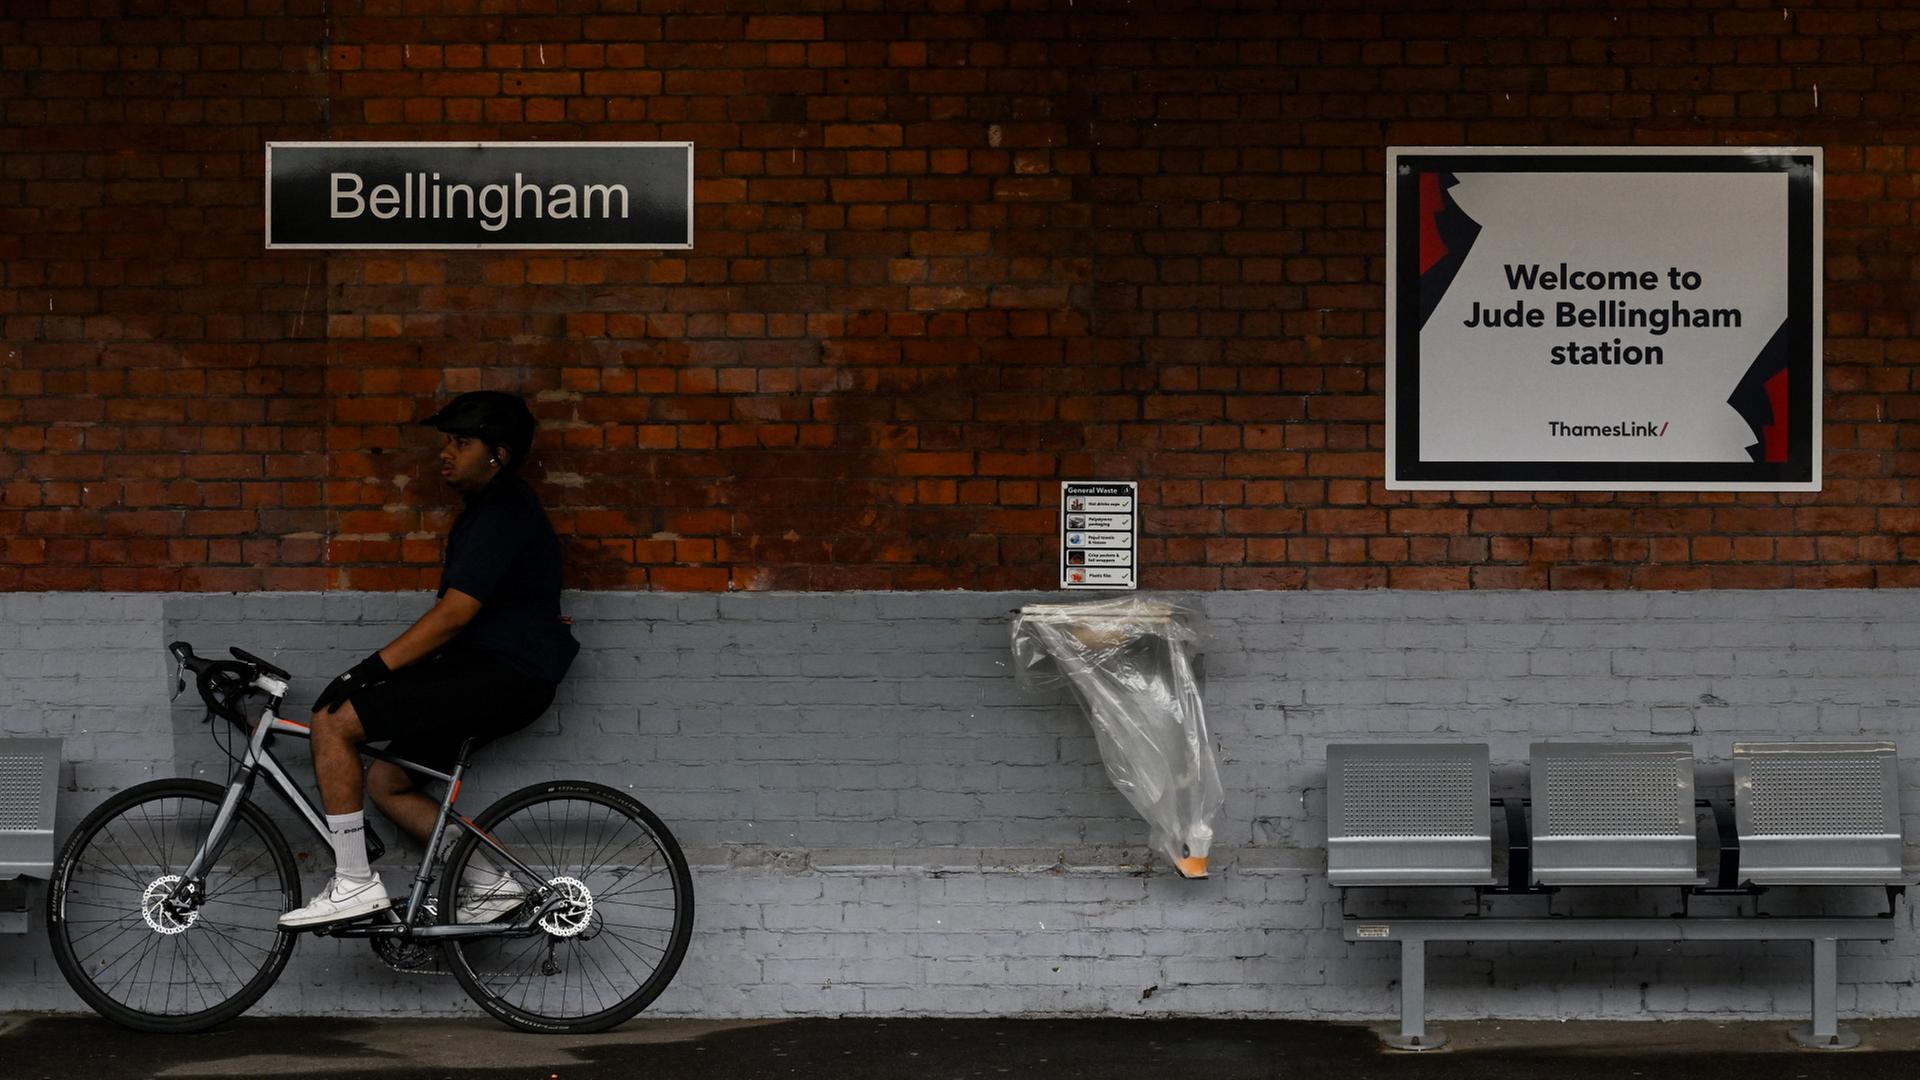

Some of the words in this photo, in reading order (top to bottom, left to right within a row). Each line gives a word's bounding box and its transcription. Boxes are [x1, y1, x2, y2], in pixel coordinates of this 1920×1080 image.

[330, 172, 629, 231] Bellingham
[1504, 263, 1659, 291] Welcome
[1668, 266, 1702, 291] to
[1463, 300, 1545, 328] Jude
[1556, 300, 1742, 336] Bellingham
[1550, 338, 1664, 365] station
